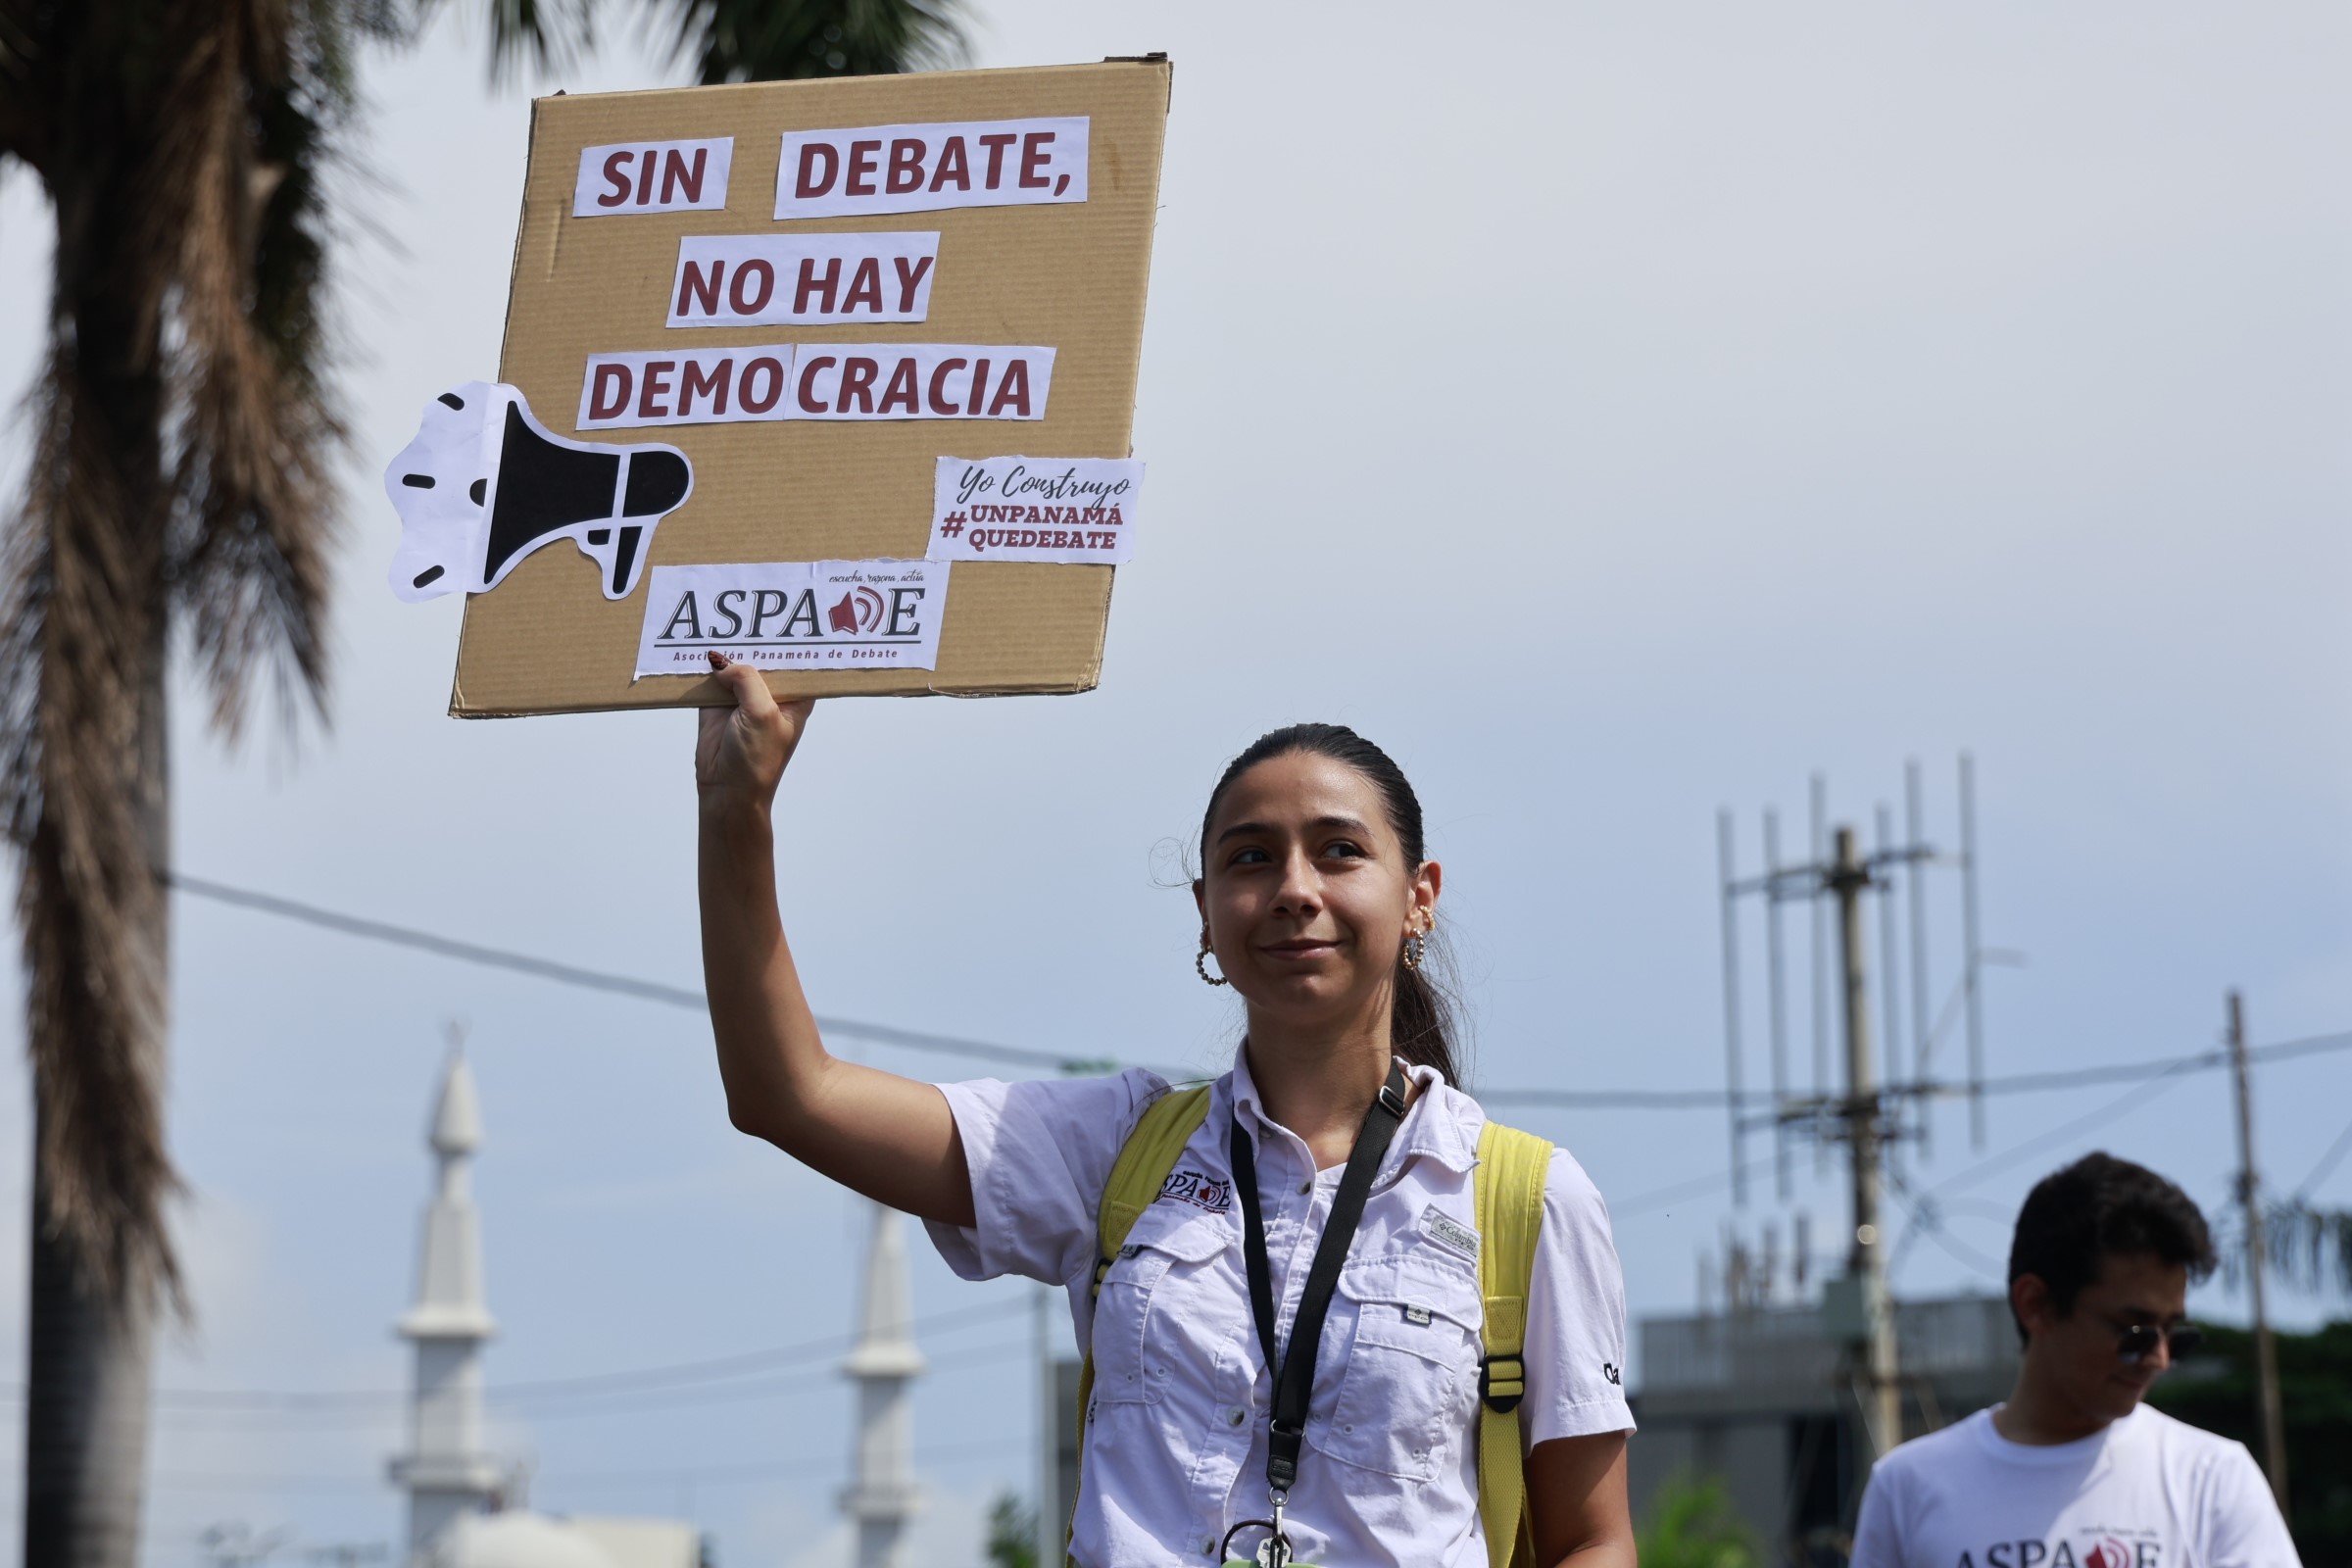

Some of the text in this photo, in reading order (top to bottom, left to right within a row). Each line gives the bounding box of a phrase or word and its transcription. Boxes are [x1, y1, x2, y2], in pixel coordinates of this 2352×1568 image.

[597, 148, 708, 208] SIN
[795, 131, 1071, 199] DEBATE,
[676, 256, 934, 317] NO HAY
[588, 356, 1032, 420] DEMOCRACIA
[956, 465, 1132, 511] Yo Construyo
[968, 528, 1116, 552] QUEDEBATE
[753, 650, 819, 660] Panameña
[828, 649, 843, 659] de
[852, 649, 898, 659] Debate
